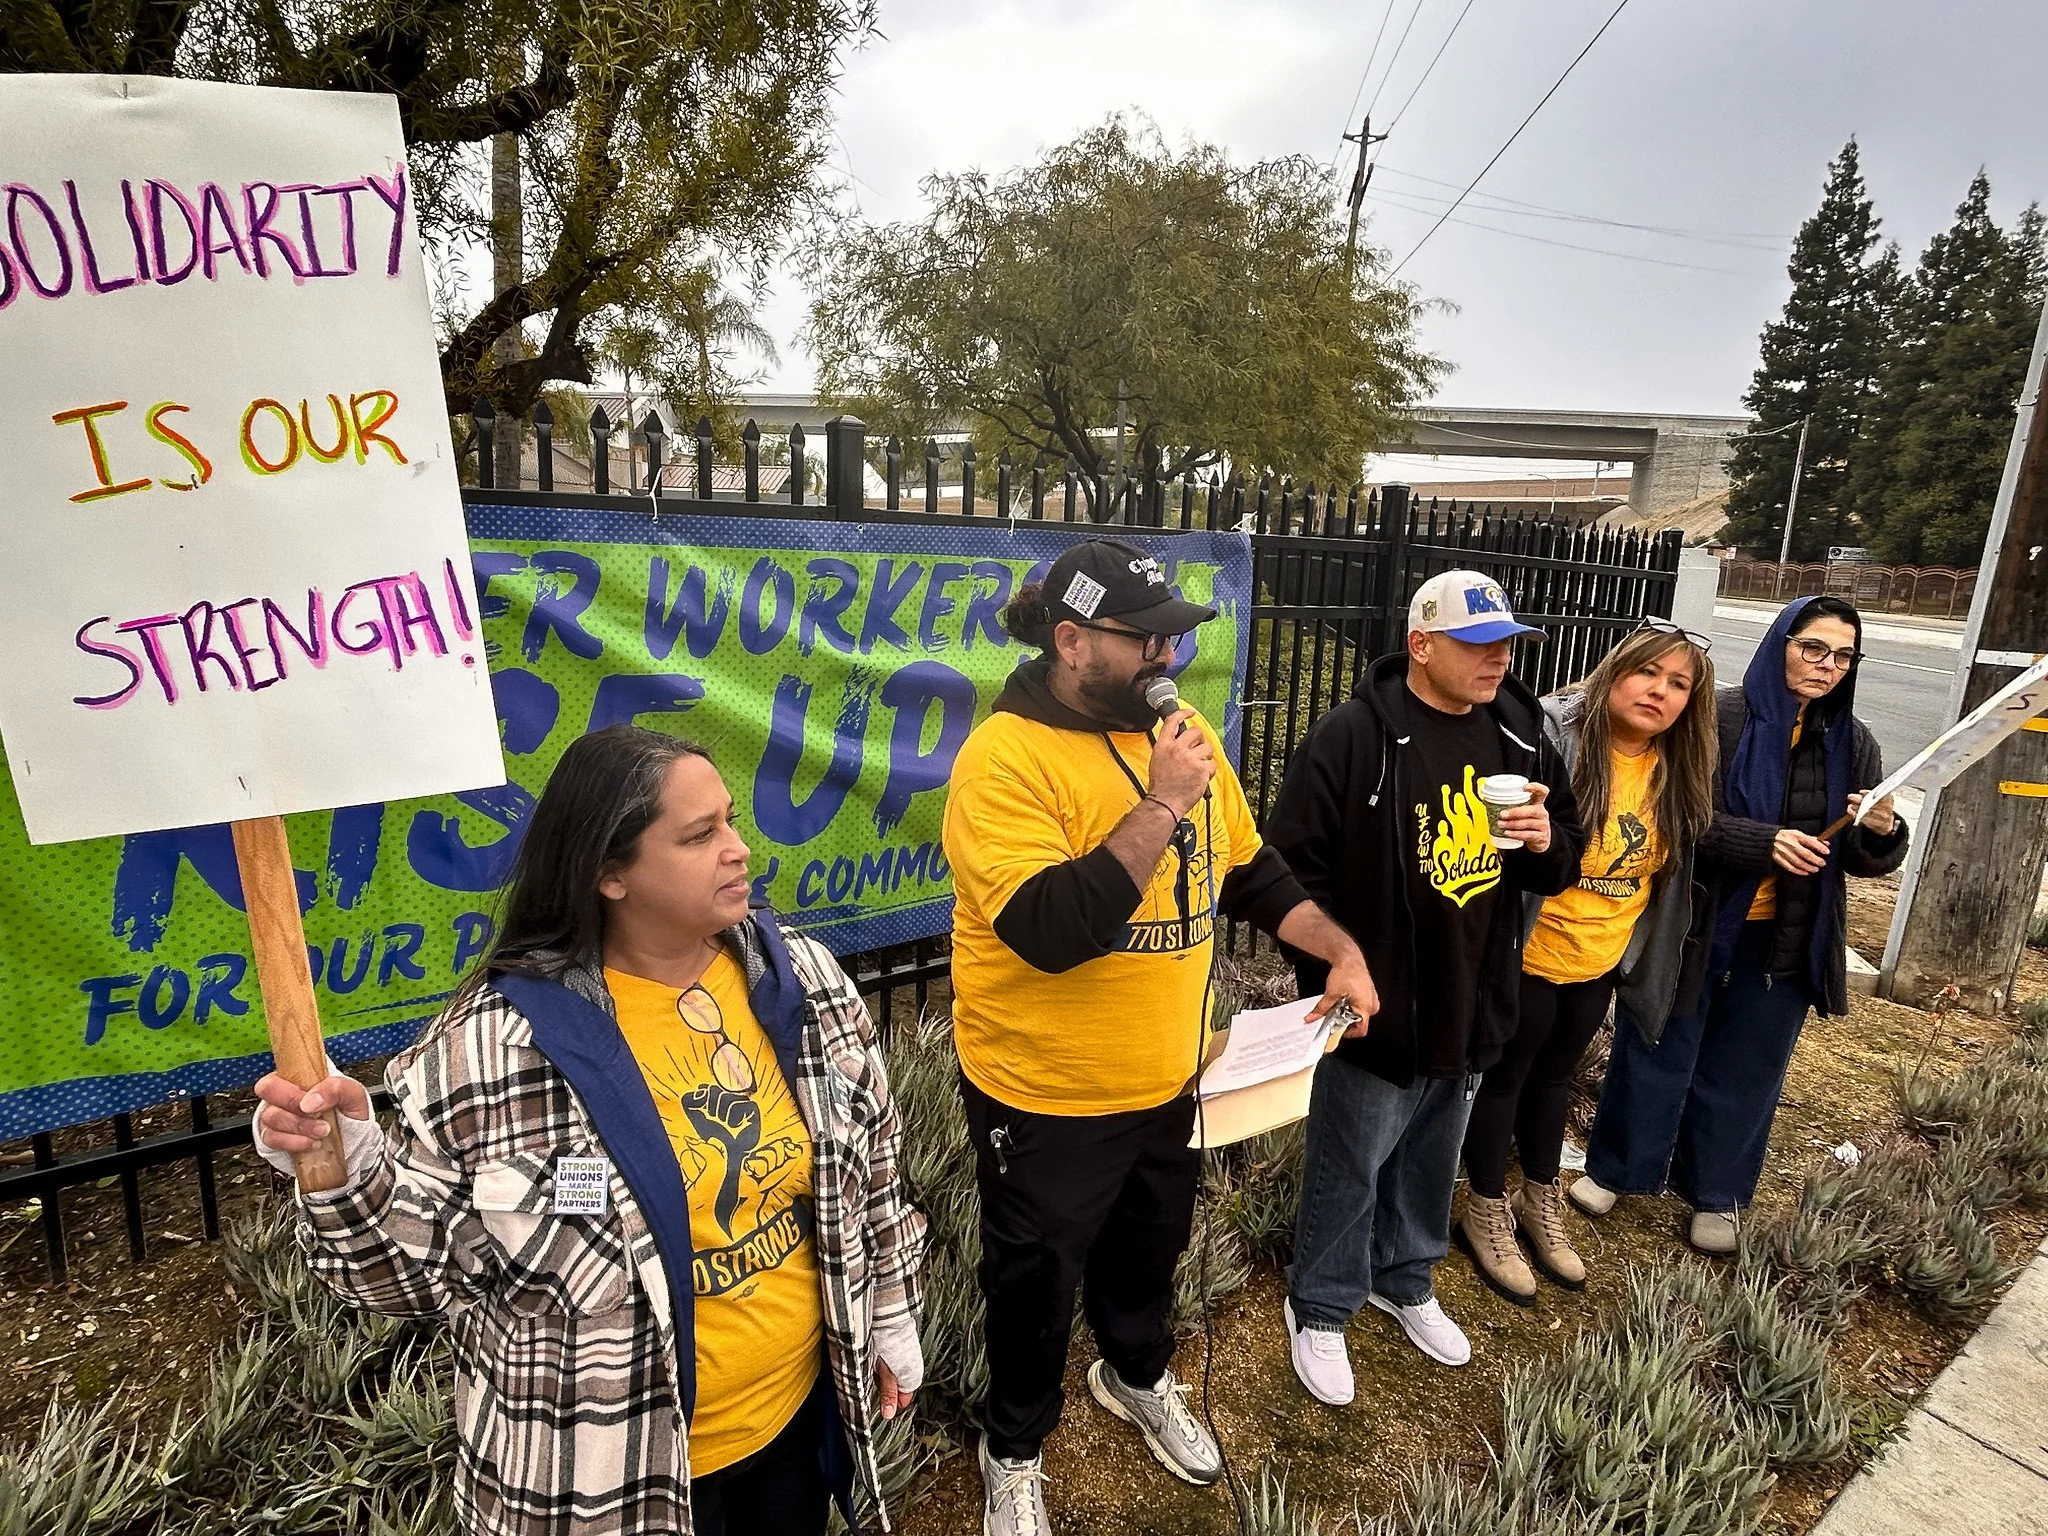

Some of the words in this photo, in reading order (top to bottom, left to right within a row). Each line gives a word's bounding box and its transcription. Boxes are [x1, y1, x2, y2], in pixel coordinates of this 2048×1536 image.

[0, 163, 406, 310] OLIDARITY
[52, 401, 213, 503] IS
[240, 390, 408, 475] OUR
[471, 550, 604, 664] ER
[644, 555, 1050, 665] WORKER
[1070, 580, 1088, 605] UNIONS
[73, 557, 475, 711] STRENGTH!
[753, 660, 978, 847] UP
[797, 841, 951, 908] COMMU
[1433, 843, 1502, 886] Solida
[1592, 878, 1636, 896] STRONG
[1126, 925, 1163, 950] 770
[81, 952, 250, 1046] FOR
[560, 1172, 603, 1181] UNIONS
[561, 1162, 604, 1171] STRONG
[558, 1200, 601, 1208] PARTNERS
[559, 1190, 602, 1199] STRONG
[711, 1210, 801, 1288] STRONG
